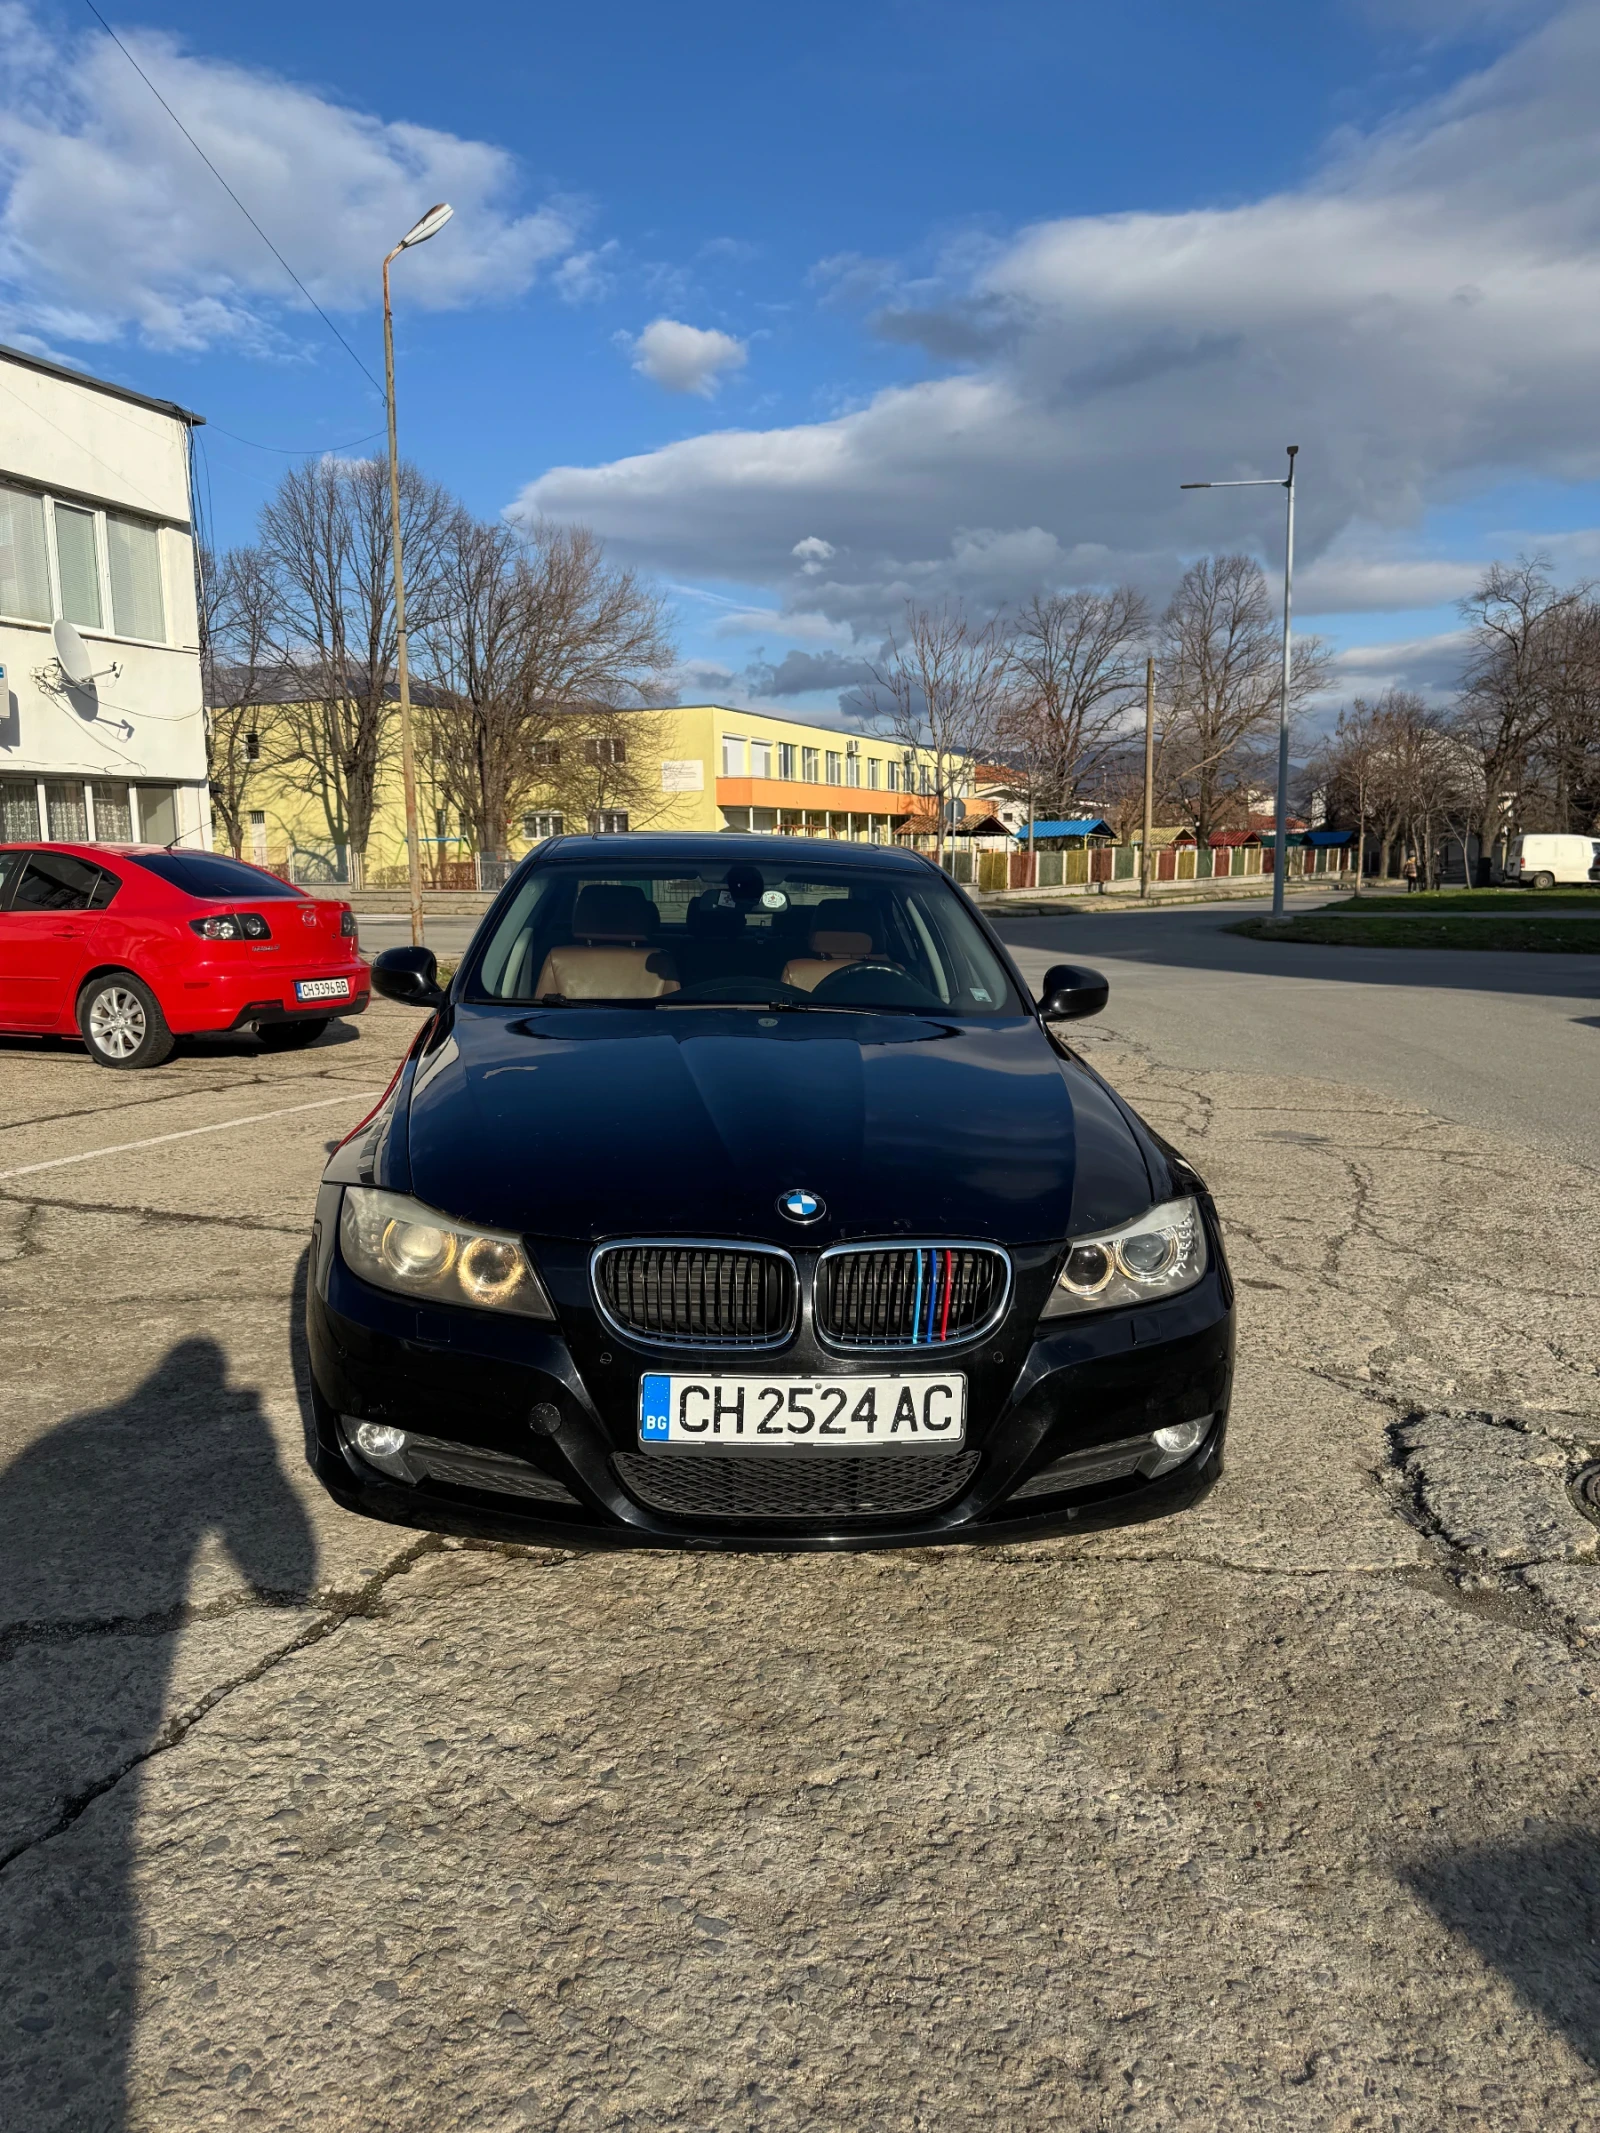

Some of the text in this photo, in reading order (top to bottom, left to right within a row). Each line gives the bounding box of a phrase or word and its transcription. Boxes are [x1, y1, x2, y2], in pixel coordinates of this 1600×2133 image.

[302, 980, 348, 997] CH 9396 BB
[679, 1383, 953, 1435] CH 2524 AC
[646, 1415, 668, 1431] BG
